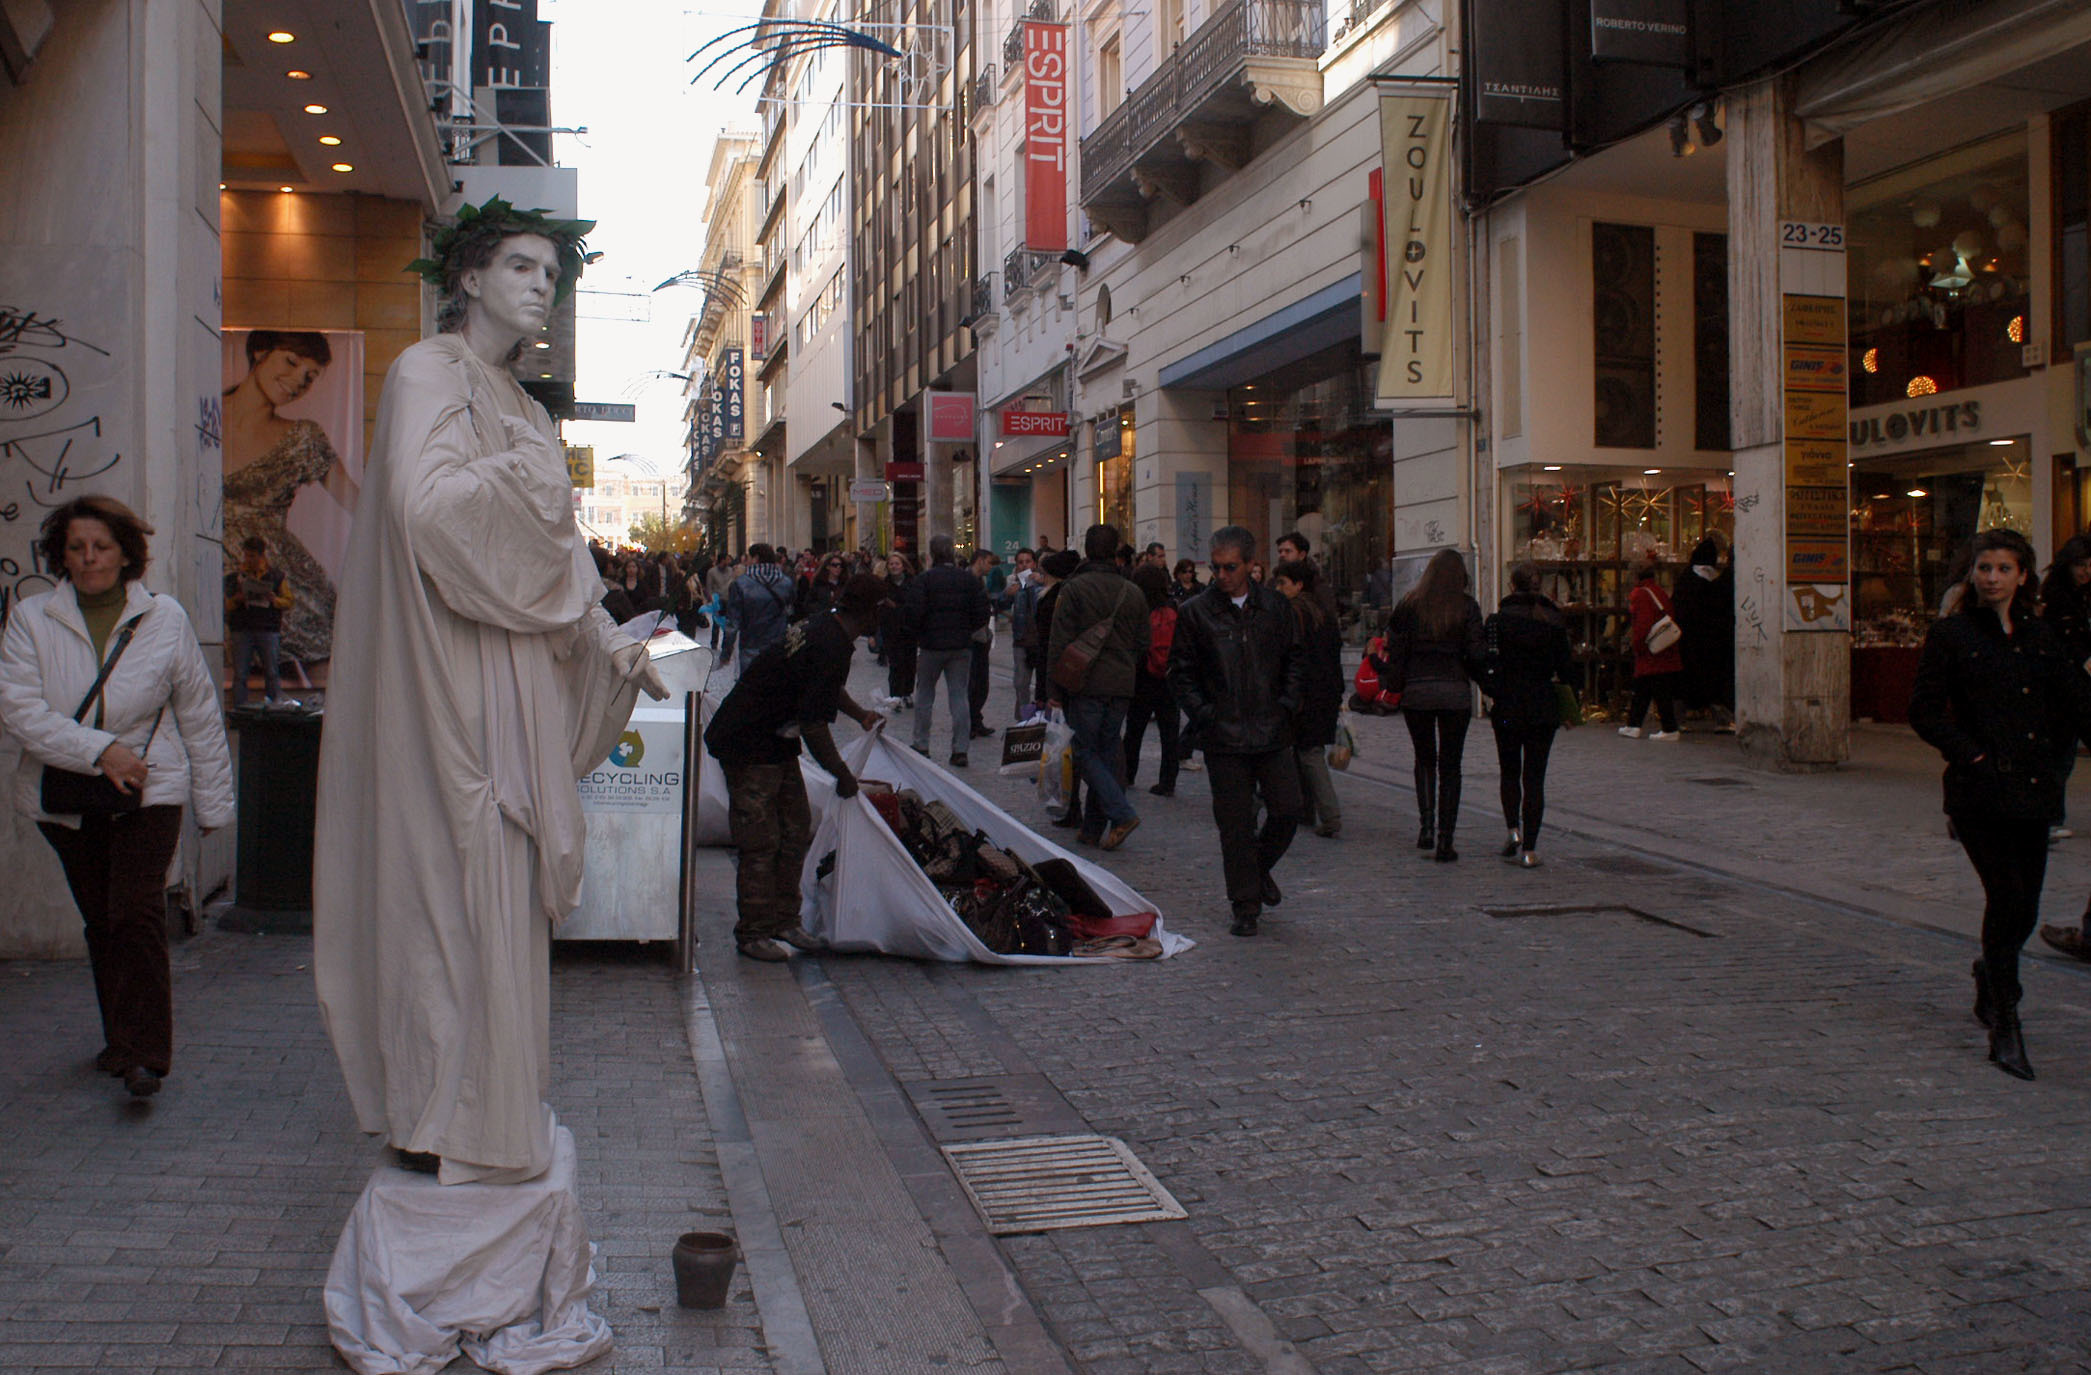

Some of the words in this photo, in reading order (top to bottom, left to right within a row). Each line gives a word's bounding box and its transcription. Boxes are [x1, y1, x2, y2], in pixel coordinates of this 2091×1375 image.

[1595, 17, 1646, 32] ROBERTO
[1647, 22, 1688, 36] VERINO
[1029, 29, 1064, 172] ESPRIT
[1484, 82, 1560, 97] ΤΣΑΝΤΙΛΗΣ
[1783, 223, 1843, 245] 23-25
[1402, 114, 1427, 385] ZOULOVITS
[729, 352, 741, 417] FOKAS
[1010, 415, 1066, 431] ESPRIT
